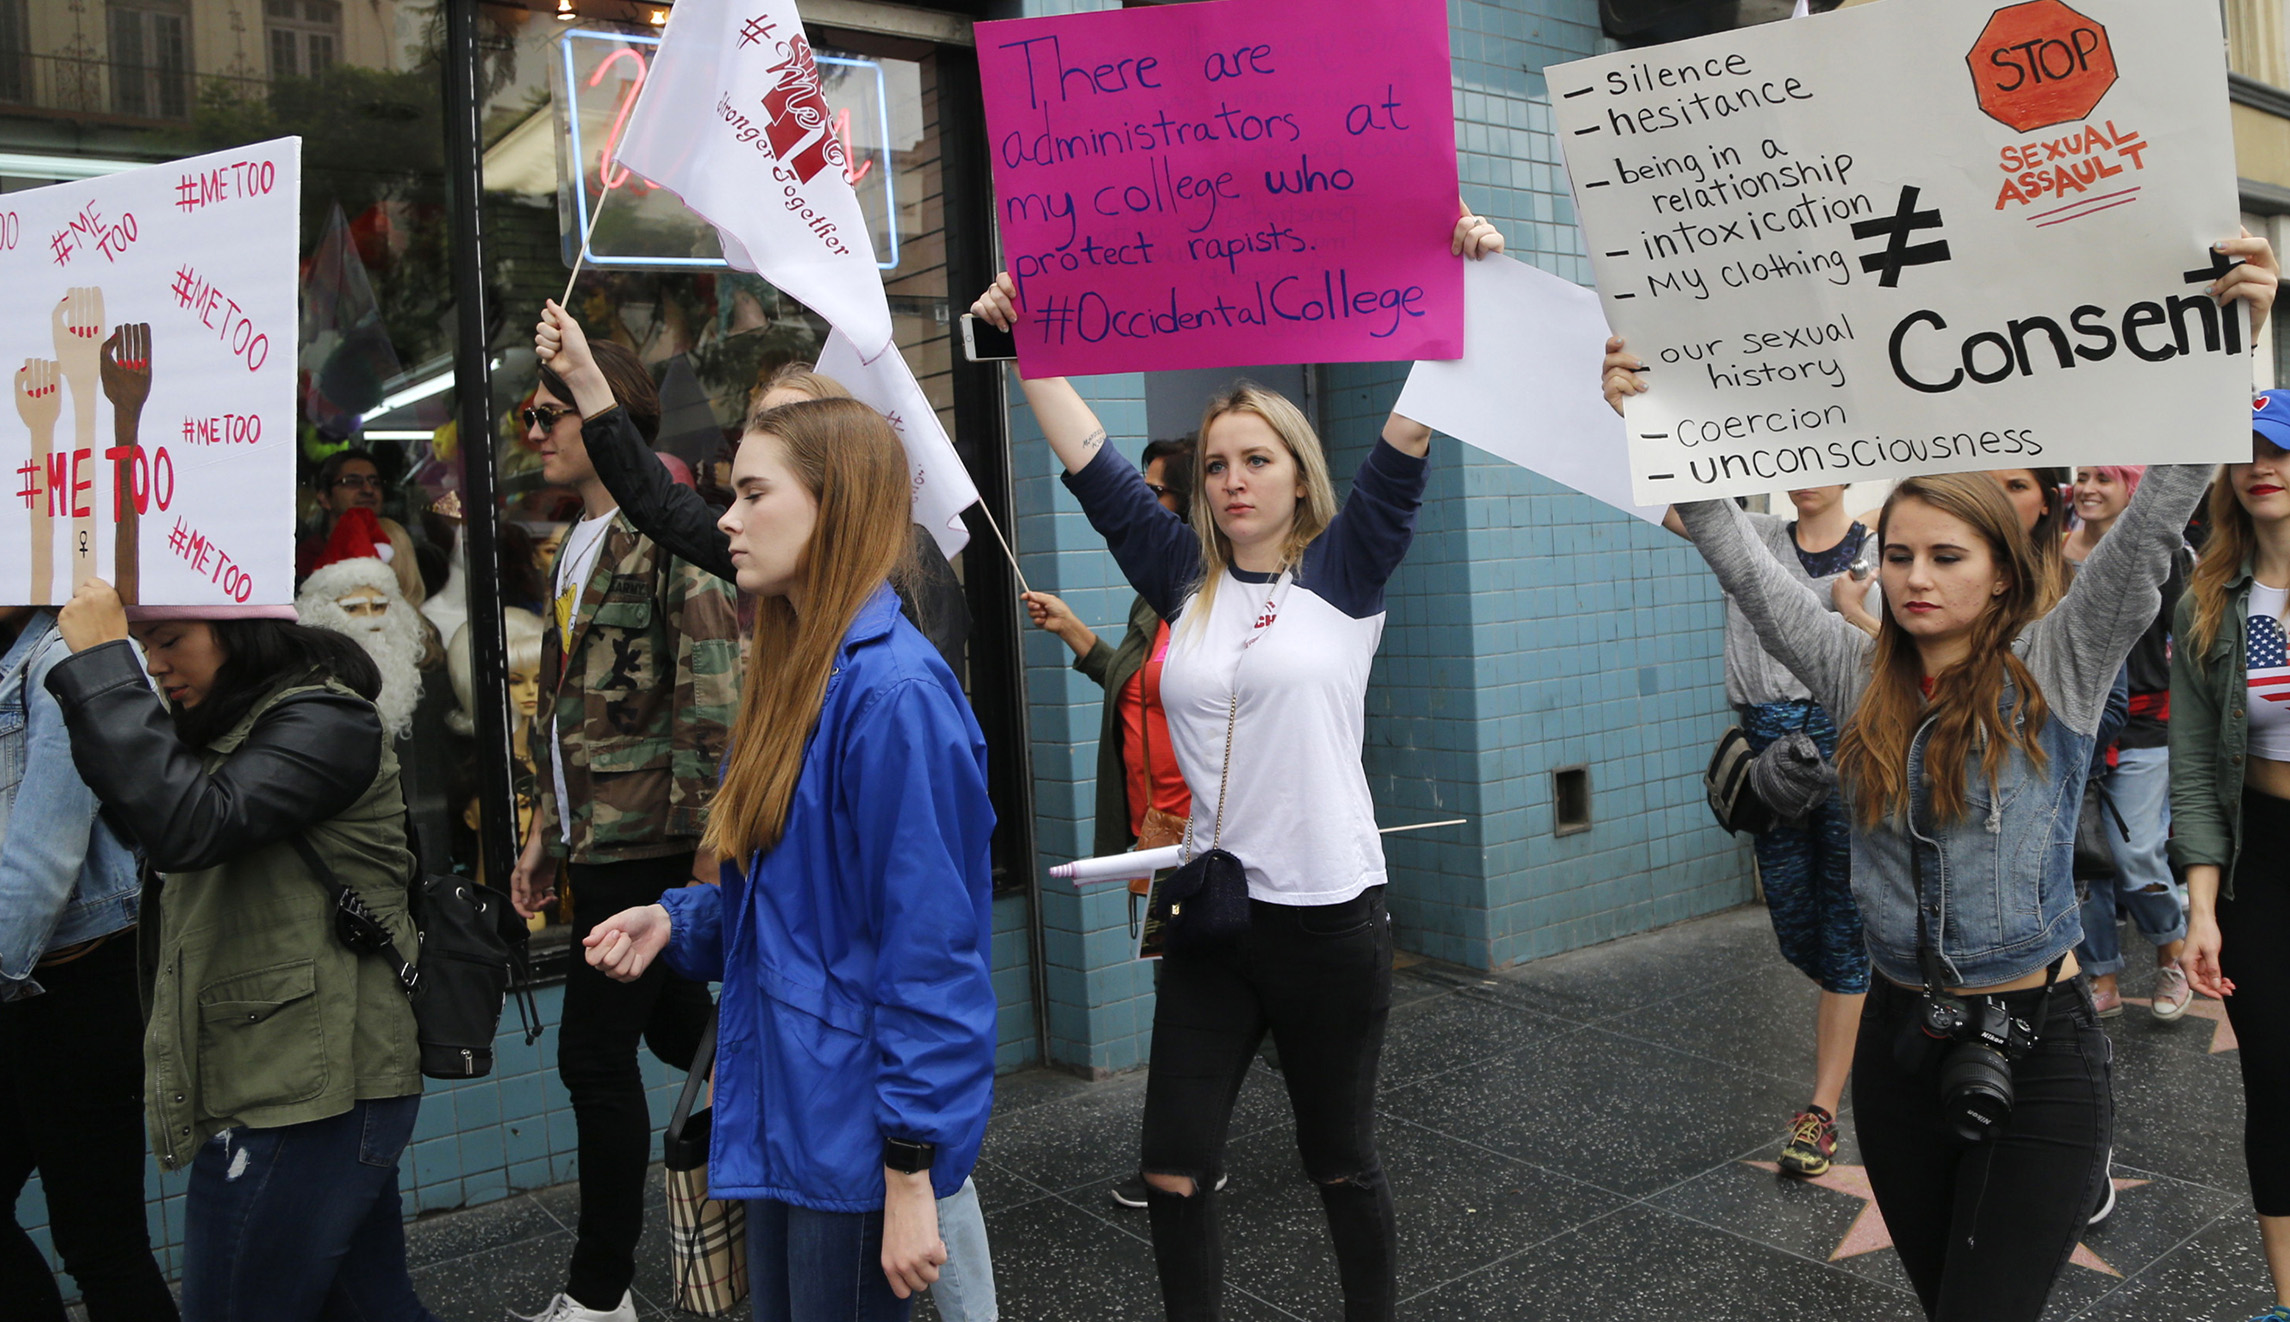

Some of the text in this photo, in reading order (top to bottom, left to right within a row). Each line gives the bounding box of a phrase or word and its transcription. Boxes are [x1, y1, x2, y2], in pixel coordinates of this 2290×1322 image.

[999, 35, 1161, 109] There
[1205, 44, 1275, 82] are
[1607, 53, 1752, 95] silence
[1990, 27, 2099, 92] STOP
[1003, 100, 1300, 168] administrators
[1346, 84, 1410, 135] at
[1607, 77, 1813, 135] hesitance
[1615, 139, 1788, 183] being in a
[1995, 141, 2148, 210] ASSAULT
[1999, 120, 2140, 173] SEXUAL
[772, 166, 849, 256] Together
[1007, 192, 1076, 251] my
[1094, 157, 1240, 233] college
[1265, 154, 1354, 194] who
[1652, 154, 1854, 214] relationship
[51, 200, 107, 267] #ME
[97, 213, 138, 262] TOO
[1642, 192, 1872, 261] intoxication
[1016, 232, 1154, 312] protect
[1188, 222, 1316, 274] rapists.
[1722, 250, 1850, 288] clothing
[1034, 270, 1425, 344] #OccidentalCollege
[1888, 246, 2246, 393] Consent
[1661, 314, 1855, 364] our sexual
[1707, 360, 1846, 390] history
[182, 414, 261, 445] #METOO
[1678, 405, 1846, 447] Coercion
[1690, 428, 2043, 484] unconsciousness
[168, 515, 252, 603] #METOO
[1980, 1031, 2004, 1044] Nikon
[1967, 1109, 1992, 1125] Nikon
